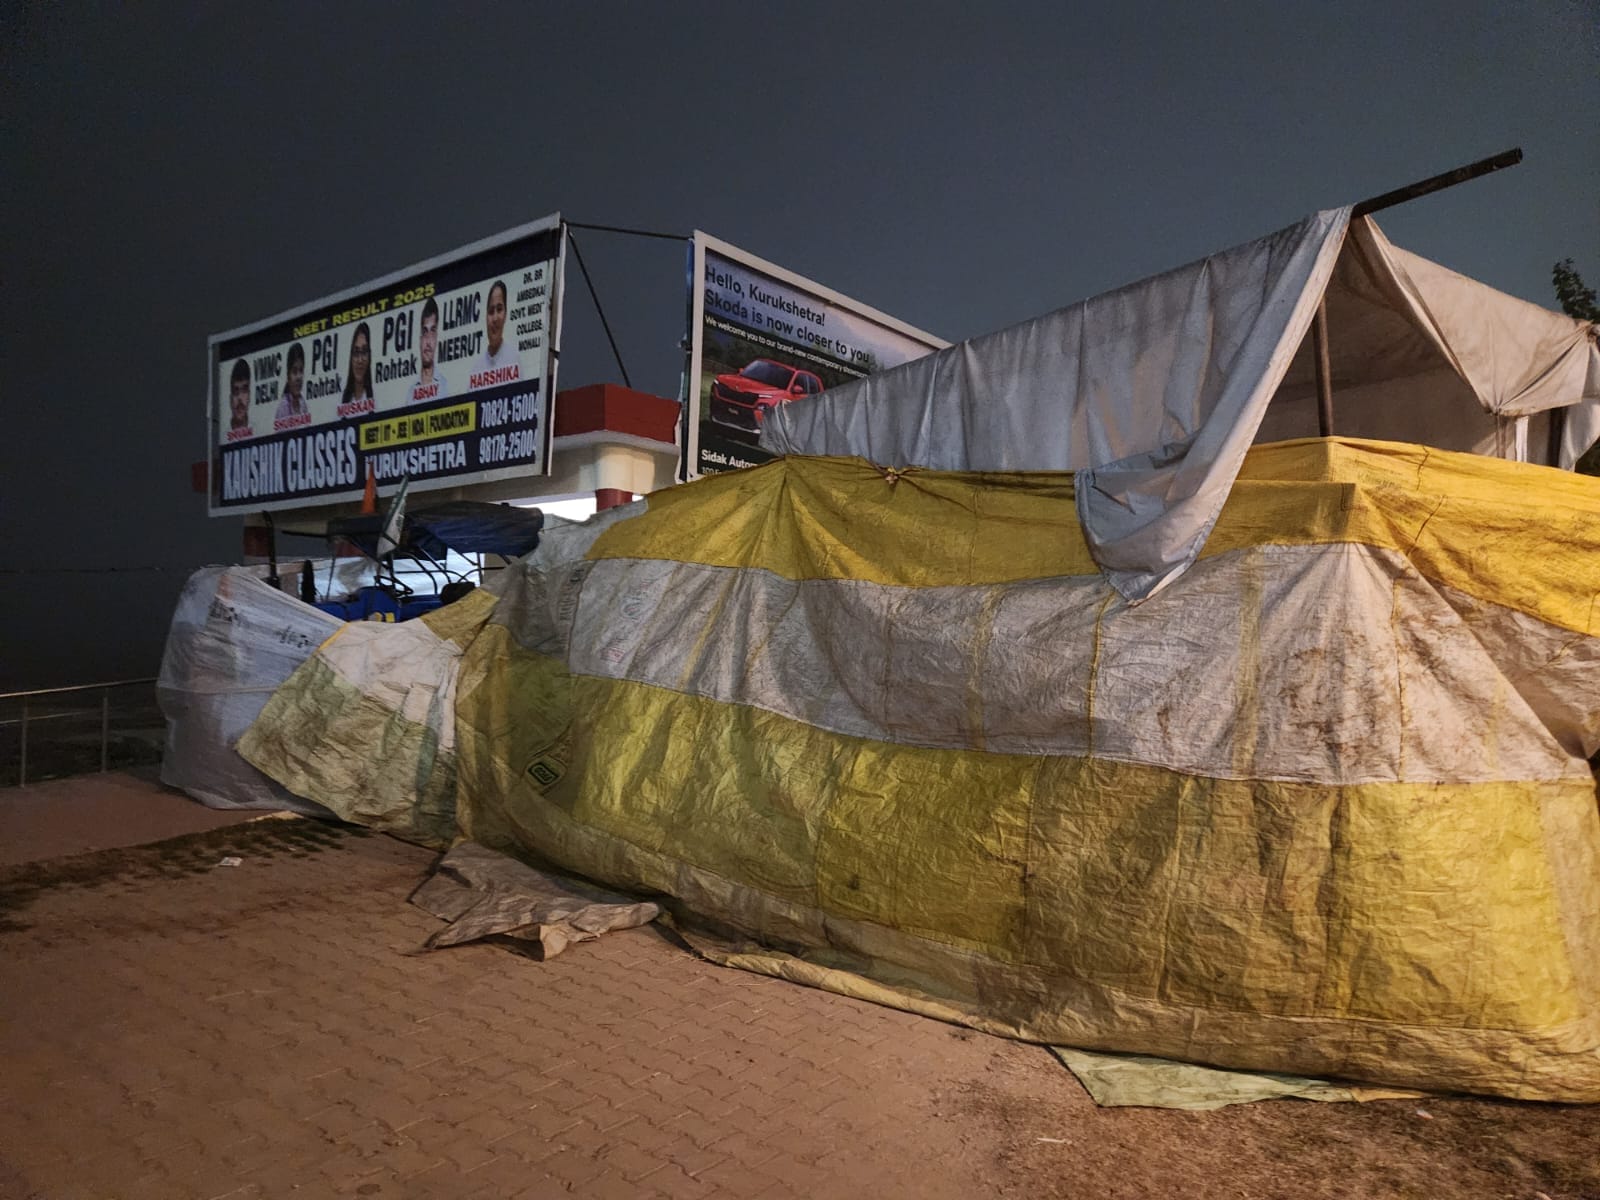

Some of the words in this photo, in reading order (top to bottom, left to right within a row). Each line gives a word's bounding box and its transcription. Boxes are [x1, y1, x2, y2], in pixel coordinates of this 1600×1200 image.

[293, 318, 329, 338] NEET
[333, 298, 389, 326] RESULT
[393, 283, 436, 307] 2025
[443, 291, 481, 331] LLRMC
[517, 285, 546, 303] AMBEDKA
[705, 264, 745, 299] Hello,
[749, 283, 826, 327] Kurukshetra!
[382, 310, 414, 356] PGI
[704, 288, 748, 319] Skoda
[752, 306, 763, 324] is
[767, 315, 794, 335] now
[797, 326, 833, 350] closer
[835, 340, 847, 355] to
[850, 347, 870, 363] you
[704, 314, 717, 328] We
[717, 321, 746, 338] welcome
[746, 331, 758, 342] you
[759, 335, 766, 344] to
[766, 339, 776, 348] our
[311, 333, 339, 375] PGI
[437, 330, 484, 364] MEERUT
[375, 353, 419, 384] Rohtak
[470, 365, 520, 389] HARSHIKA
[306, 373, 342, 400] Rohtak
[413, 384, 439, 401] ABHAY
[337, 399, 375, 417] MUSKAN
[223, 440, 286, 500] KAUSHIK
[286, 426, 357, 493] CLASSES
[701, 449, 727, 465] Sidak
